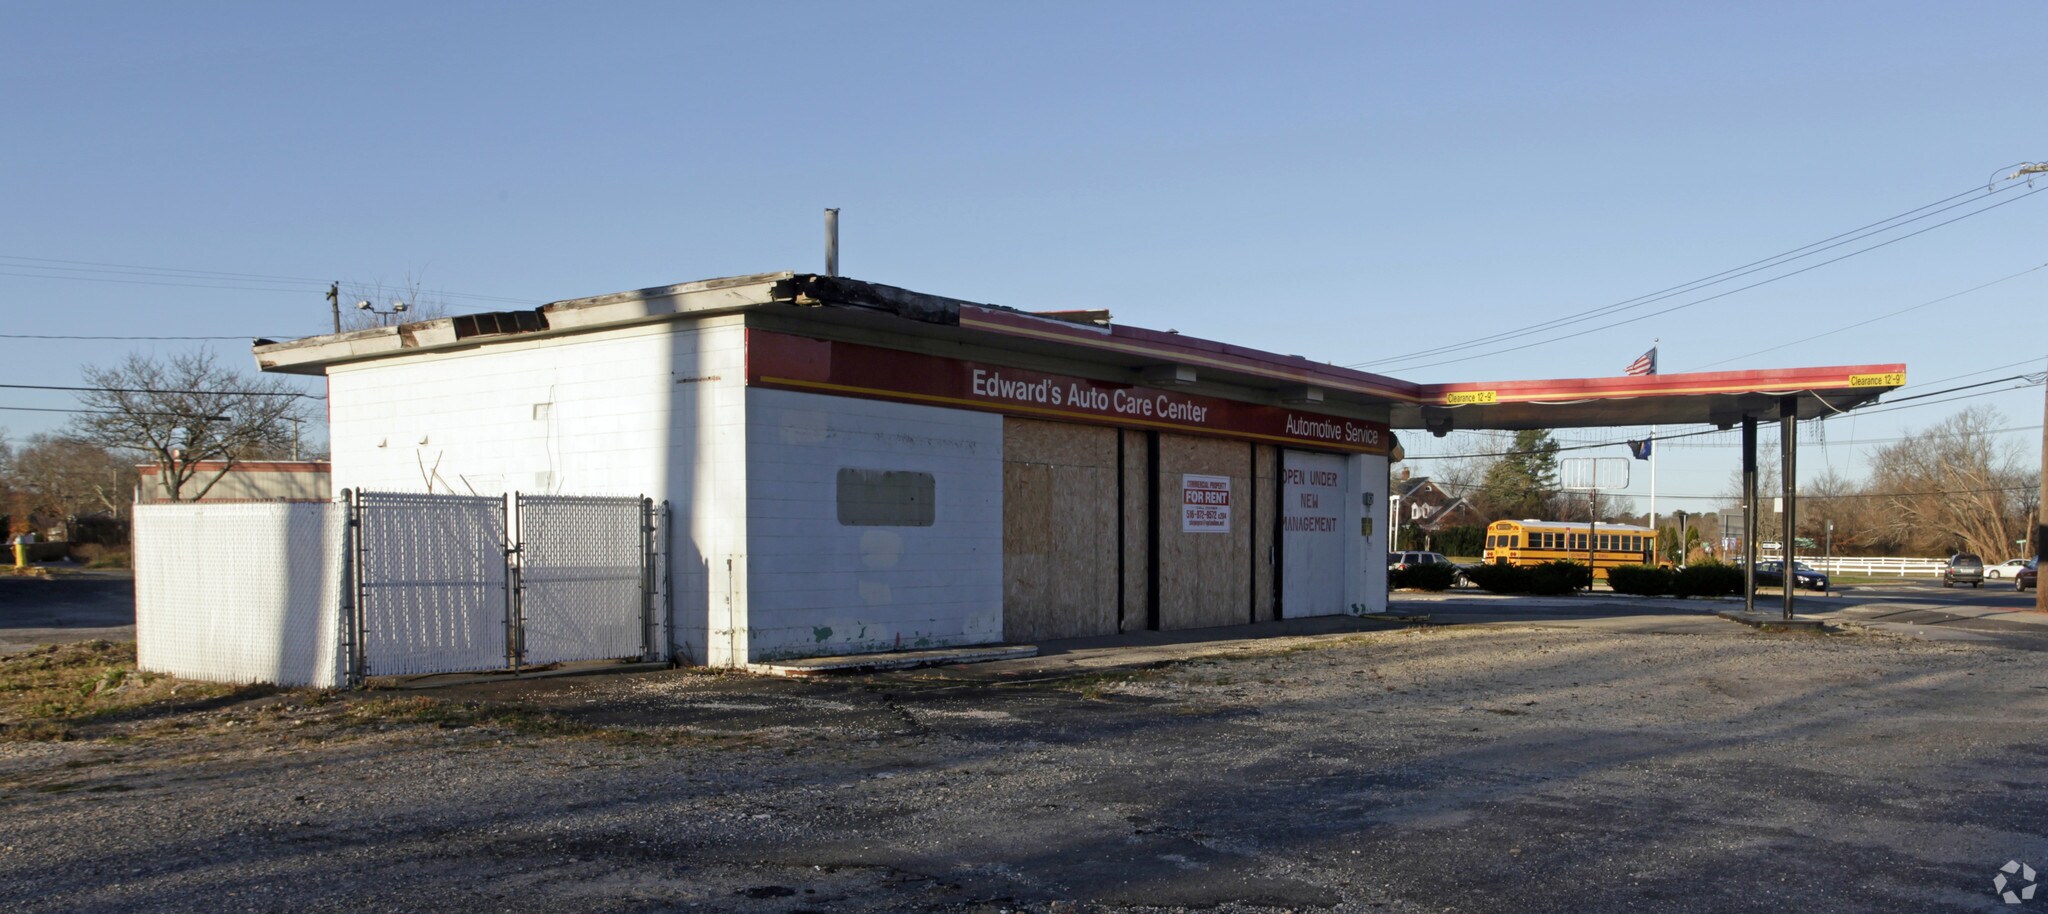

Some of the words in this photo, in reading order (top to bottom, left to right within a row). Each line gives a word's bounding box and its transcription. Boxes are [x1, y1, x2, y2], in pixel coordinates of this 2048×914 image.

[1851, 375, 1882, 386] Clearance
[973, 369, 1062, 405] Edward's
[1067, 383, 1109, 411] Auto
[1114, 389, 1152, 416] Care
[1156, 395, 1207, 422] Center
[1448, 392, 1475, 403] Clearance
[1286, 413, 1341, 440] Automotive
[1345, 421, 1379, 445] Service
[1282, 468, 1305, 485] OPEN
[1310, 470, 1337, 487] UNDER
[1186, 490, 1204, 503] FOR
[1205, 491, 1228, 504] RENT
[1300, 493, 1319, 509] NEW
